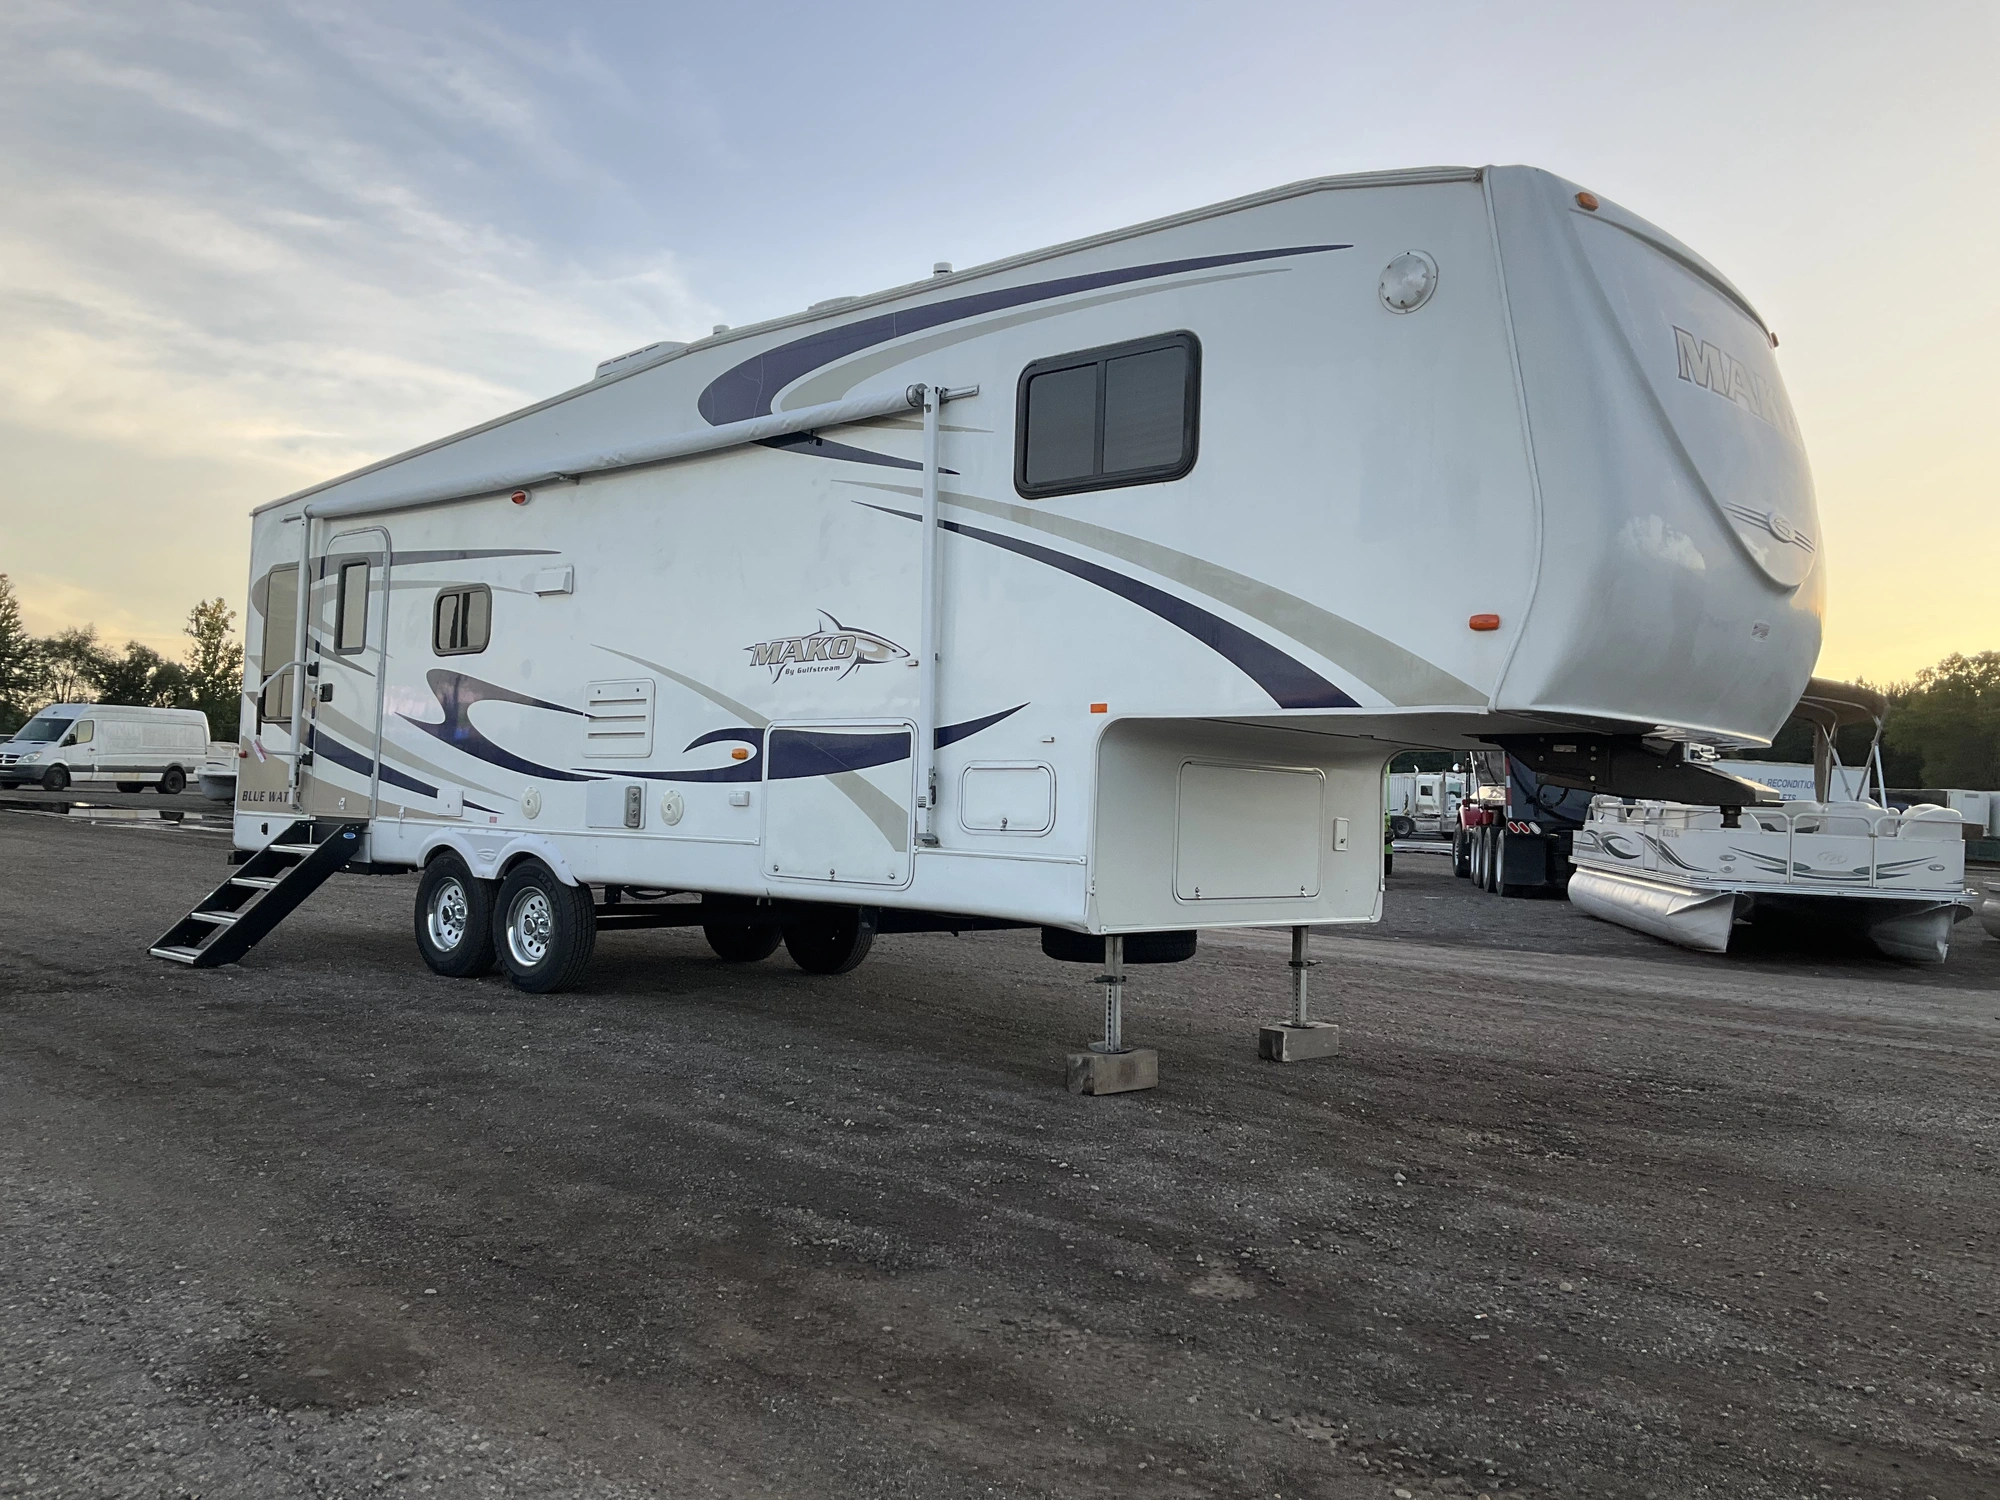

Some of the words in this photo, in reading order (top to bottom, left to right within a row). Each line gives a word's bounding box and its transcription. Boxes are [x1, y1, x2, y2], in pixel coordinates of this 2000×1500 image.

[750, 635, 857, 667] MAKO
[785, 666, 795, 676] By
[797, 664, 841, 674] Gulfstream
[242, 790, 266, 802] BLUE
[268, 791, 301, 803] WATR
